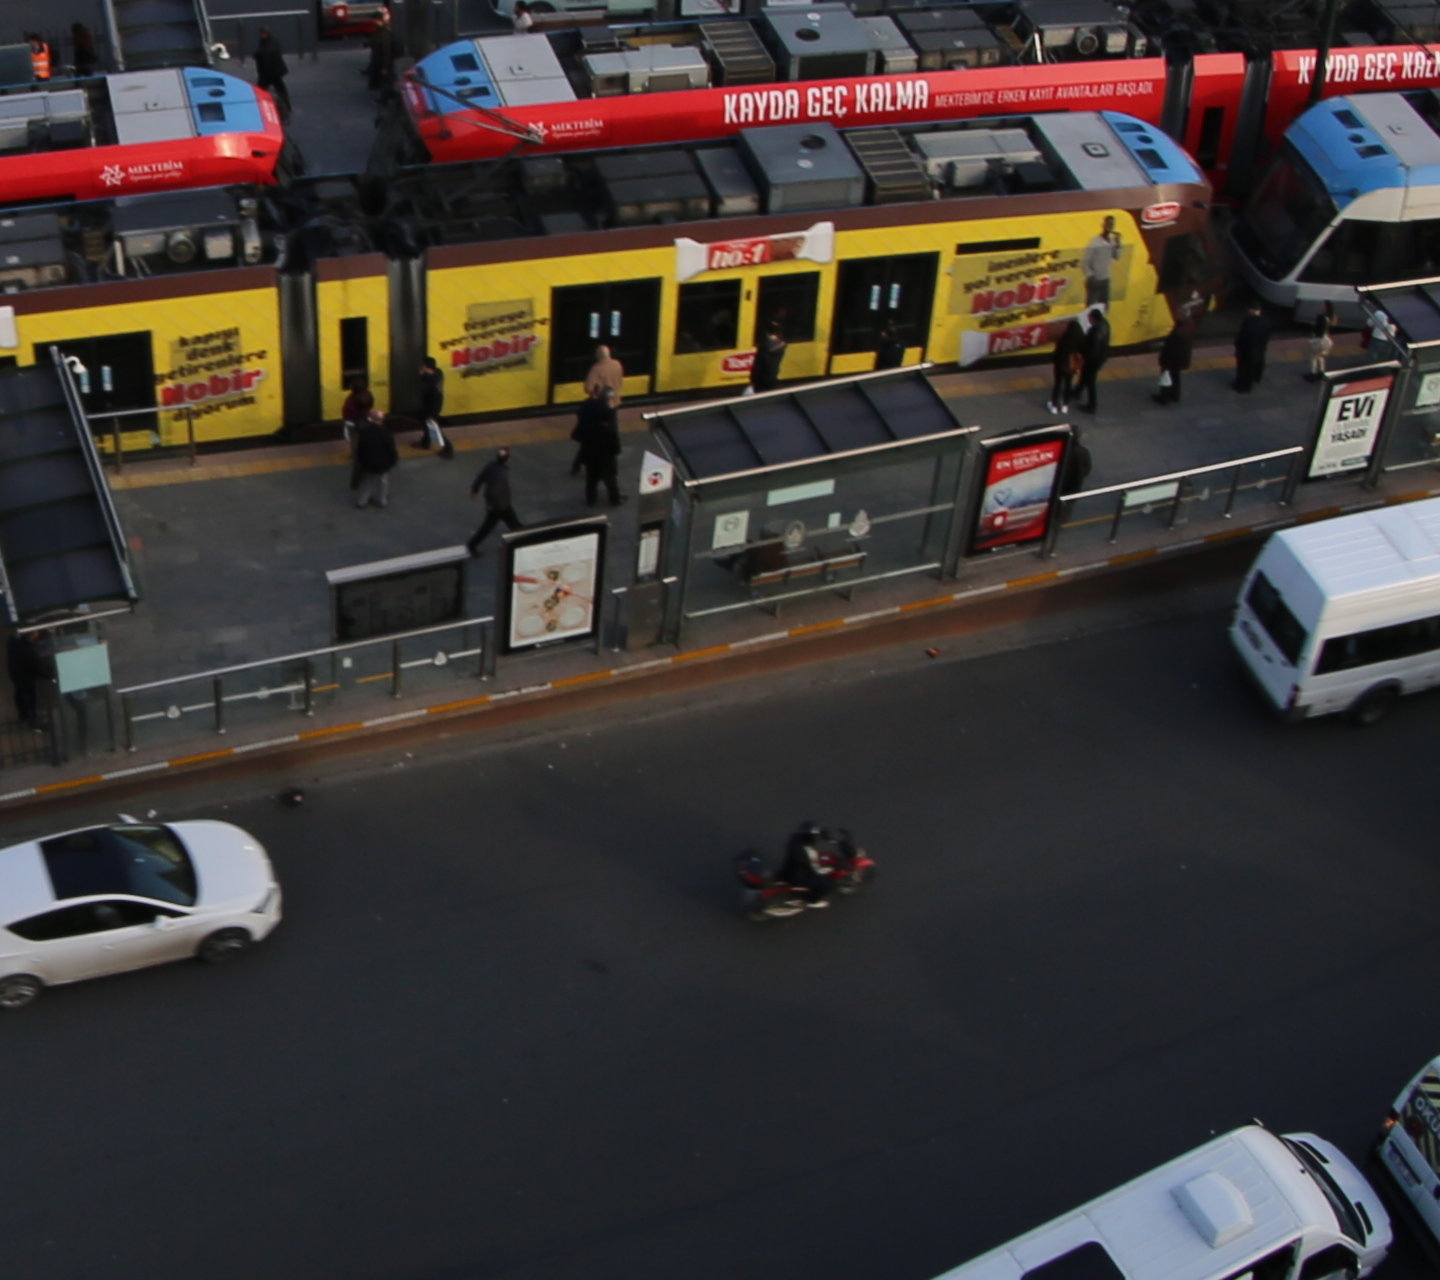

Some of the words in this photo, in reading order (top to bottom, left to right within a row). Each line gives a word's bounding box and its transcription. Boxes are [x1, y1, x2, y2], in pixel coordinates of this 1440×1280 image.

[1298, 54, 1358, 85] KYDA
[1363, 53, 1396, 81] GEÇ
[723, 88, 800, 124] KAYDA
[807, 86, 848, 119] GEÇ
[854, 80, 930, 115] KALMA
[935, 90, 995, 108] MEKTEBİM'DE
[997, 88, 1026, 105] ERKEN
[1028, 86, 1054, 104] KAYIT
[1056, 83, 1115, 103] AVANTAJLARI
[971, 277, 1068, 316] Nobir
[450, 333, 540, 369] Nobir
[161, 368, 265, 407] Nobir
